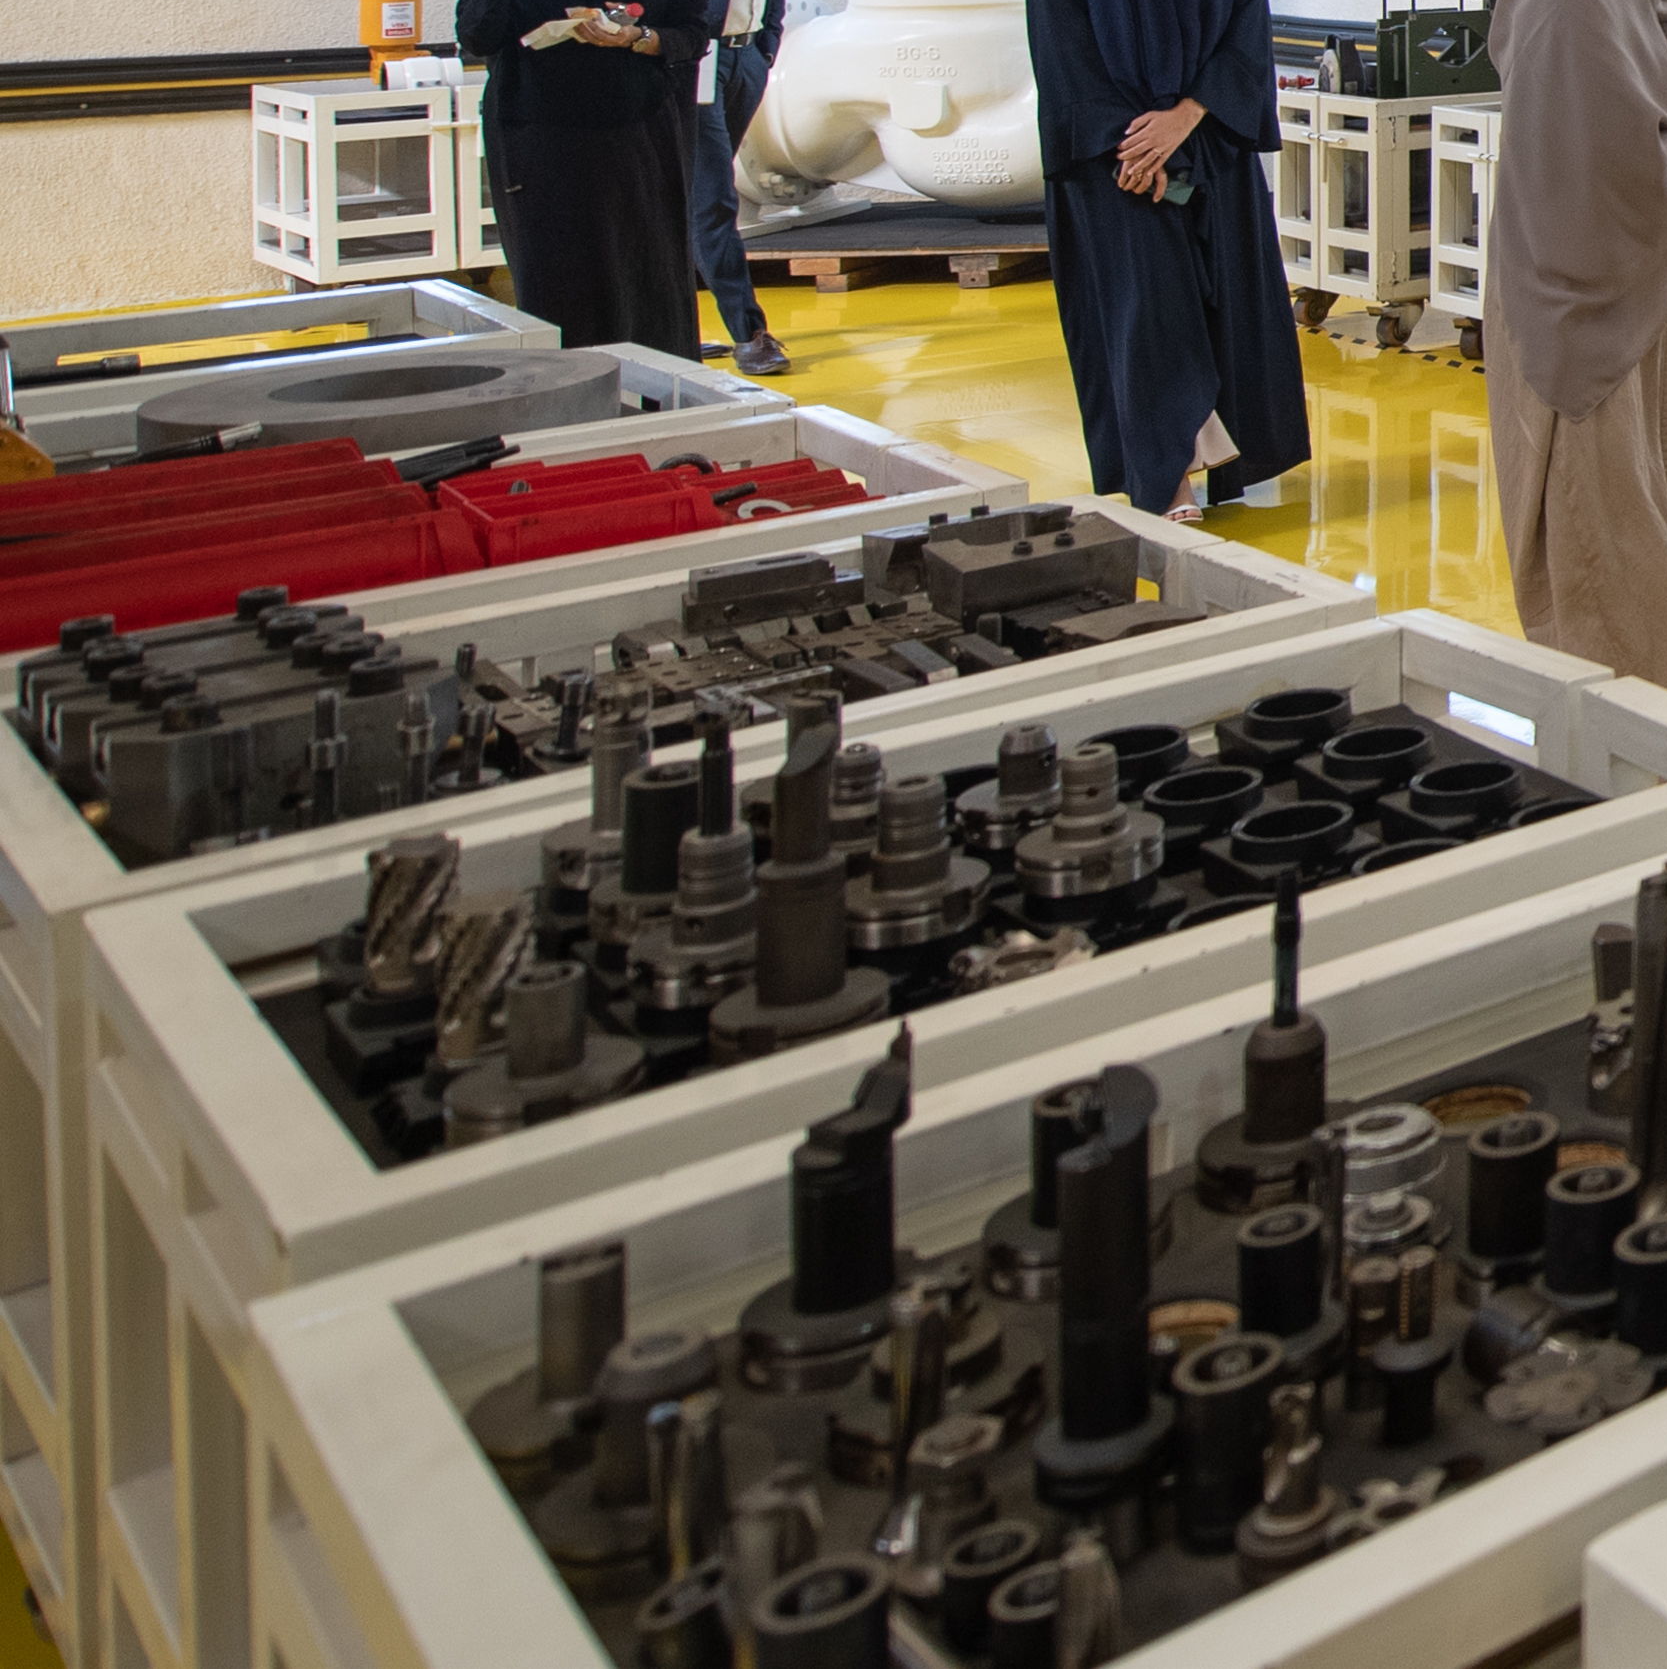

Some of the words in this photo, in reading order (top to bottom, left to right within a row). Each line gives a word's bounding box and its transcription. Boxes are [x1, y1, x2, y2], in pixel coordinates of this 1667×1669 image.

[903, 66, 921, 78] CL
[925, 65, 958, 78] 300
[953, 137, 979, 149] VBG
